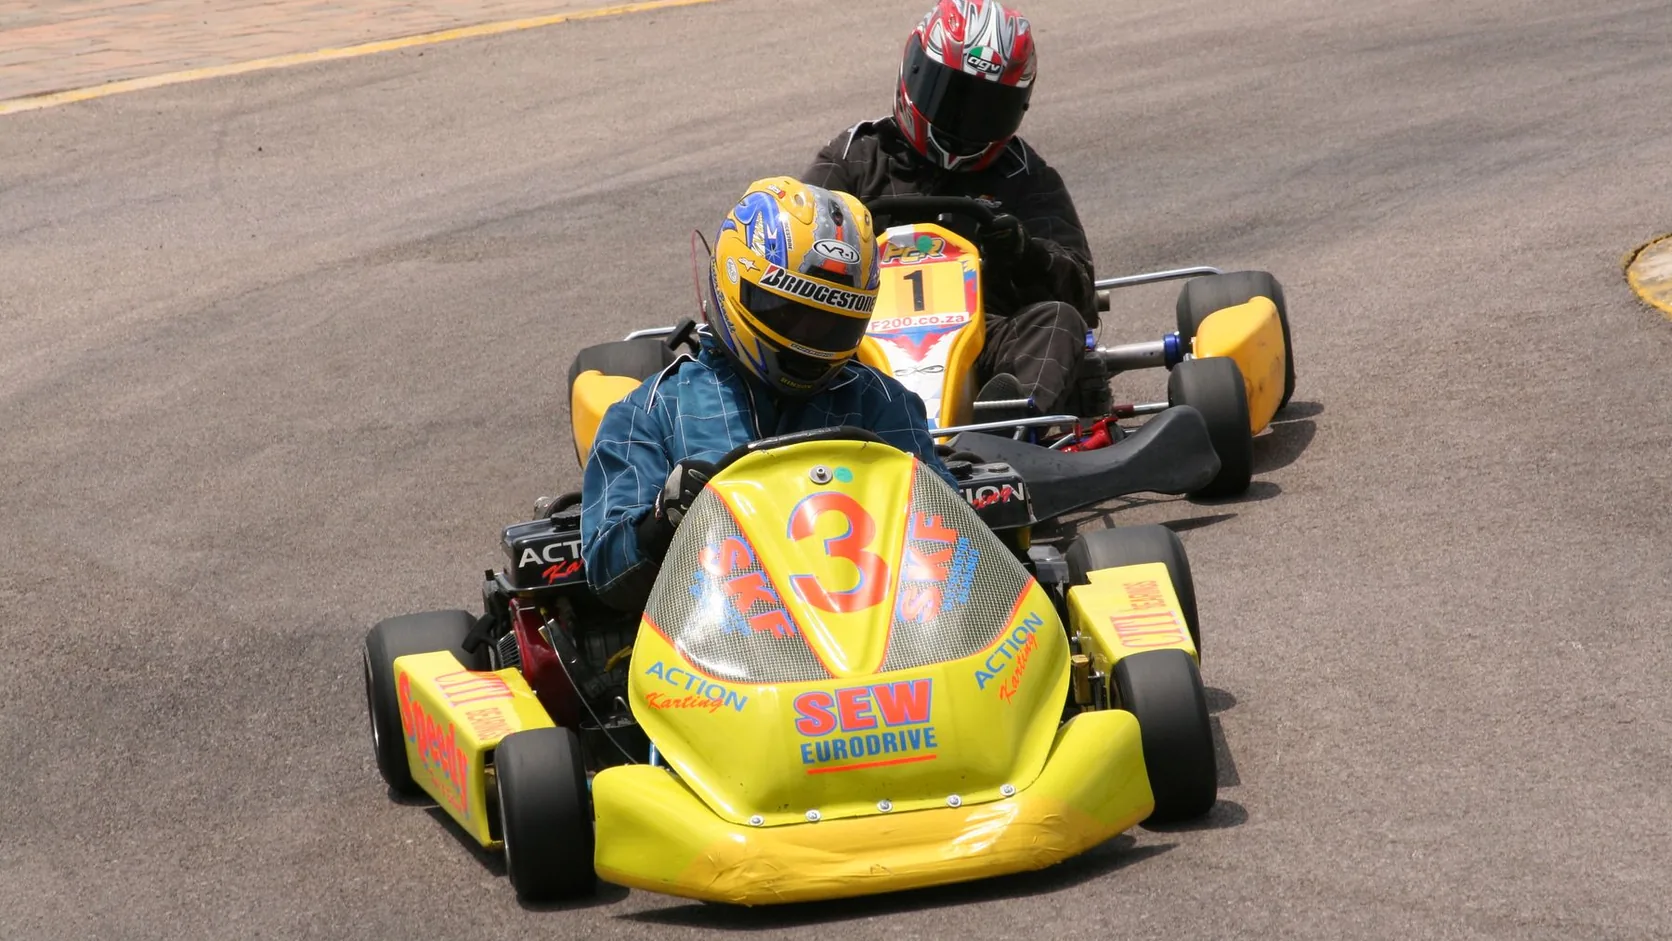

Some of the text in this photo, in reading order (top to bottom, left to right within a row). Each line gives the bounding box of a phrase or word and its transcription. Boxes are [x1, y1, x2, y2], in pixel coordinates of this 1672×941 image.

[968, 55, 1001, 72] agv
[820, 243, 856, 261] VR-1
[760, 265, 876, 313] BRIDGESTONE
[903, 269, 925, 312] 1
[871, 313, 965, 330] F200.co.za
[518, 540, 581, 568] ACT
[787, 491, 890, 613] 3
[896, 511, 959, 624] SKF
[700, 534, 797, 640] SKF
[975, 612, 1044, 690] ACTION
[1000, 632, 1039, 704] Karting
[644, 691, 726, 713] Karting
[645, 661, 748, 712] ACTION
[793, 678, 933, 737] SEW
[398, 671, 469, 819] Speedy
[801, 727, 937, 764] EURODRIVE
